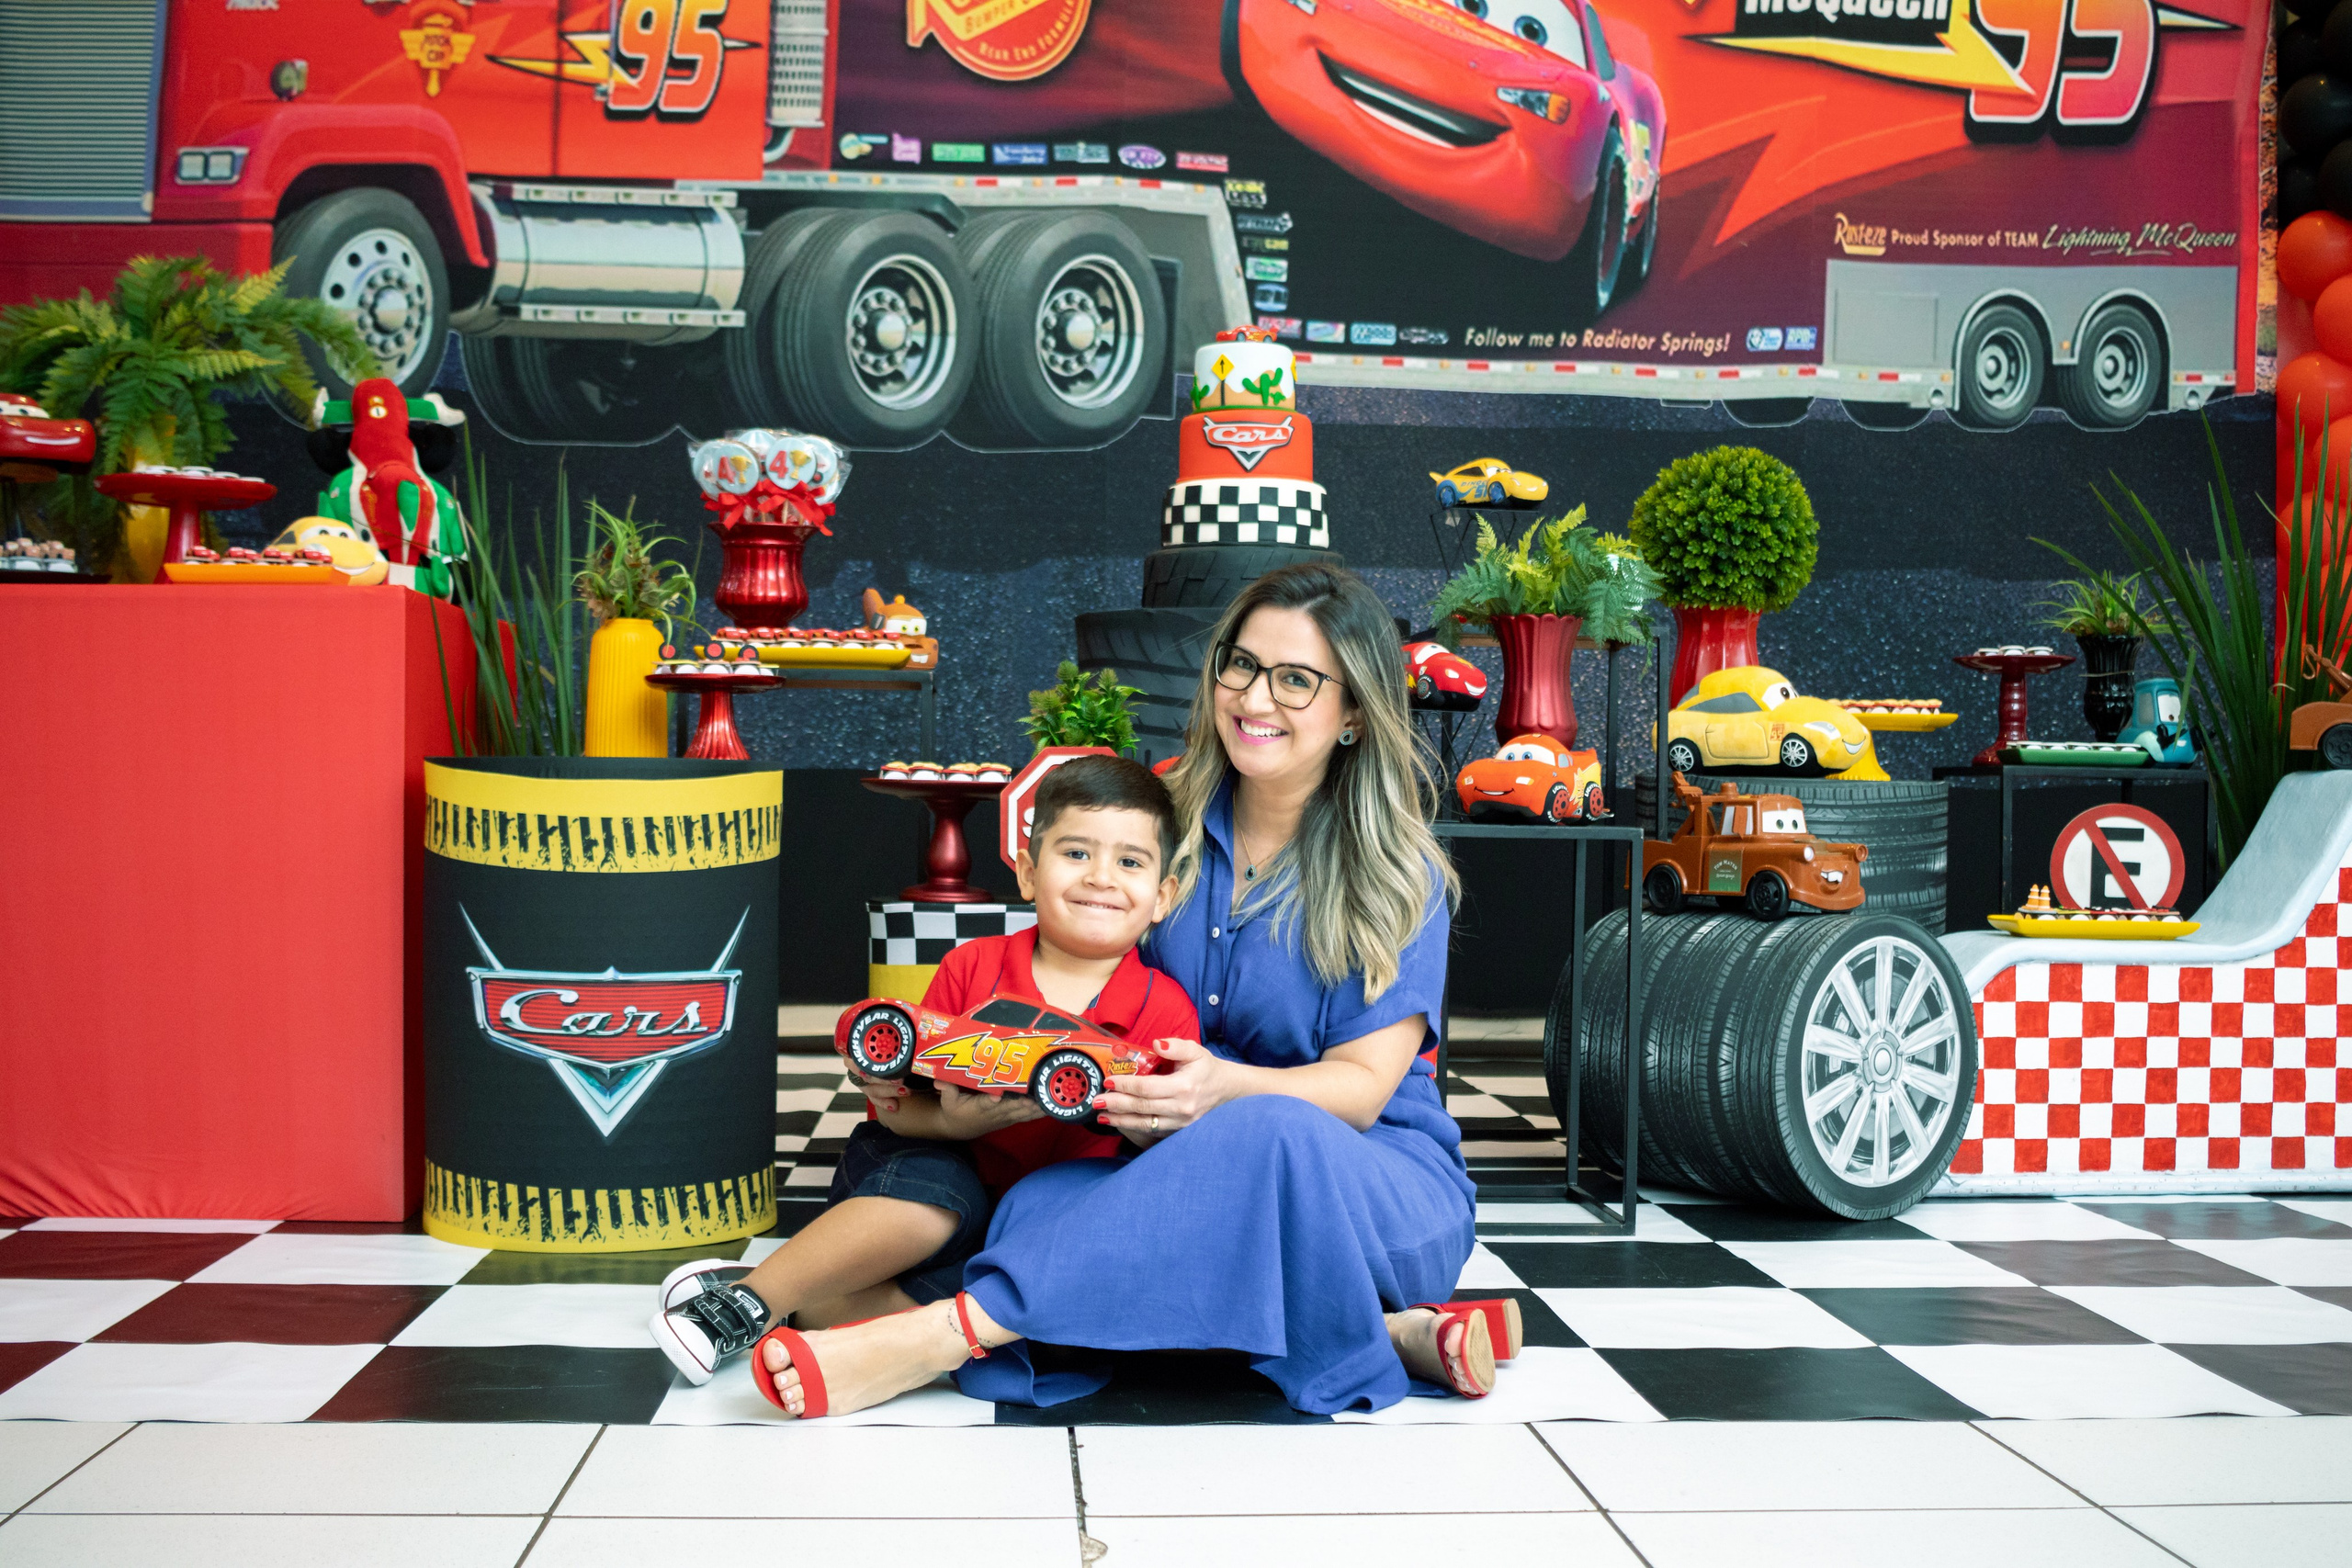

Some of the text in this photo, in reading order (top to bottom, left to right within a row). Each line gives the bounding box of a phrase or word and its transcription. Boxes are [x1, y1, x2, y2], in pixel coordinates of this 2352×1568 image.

[607, 0, 727, 113] 95
[1891, 229, 1928, 246] Proud
[1932, 229, 1984, 250] Sponsor
[1987, 230, 2002, 247] of
[2004, 231, 2039, 248] TEAM
[2041, 223, 2132, 256] Lightning
[2135, 221, 2237, 254] McQueen
[1464, 327, 1524, 347] Follow
[1528, 332, 1555, 347] me
[1559, 331, 1577, 348] to
[1582, 328, 1656, 351] Radiator
[1659, 331, 1732, 357] Springs!
[1212, 427, 1288, 444] Cars
[718, 456, 735, 484] 4
[768, 450, 788, 479] 4
[2089, 827, 2144, 908] E
[500, 988, 709, 1036] Cars
[851, 1011, 890, 1068] LIGHTYEAR
[871, 1018, 910, 1073] LIGHTYEAR
[967, 1037, 1030, 1085] 95
[1037, 1066, 1084, 1117] LIGHTYEAR
[1053, 1054, 1100, 1105] LIGHTYEAR
